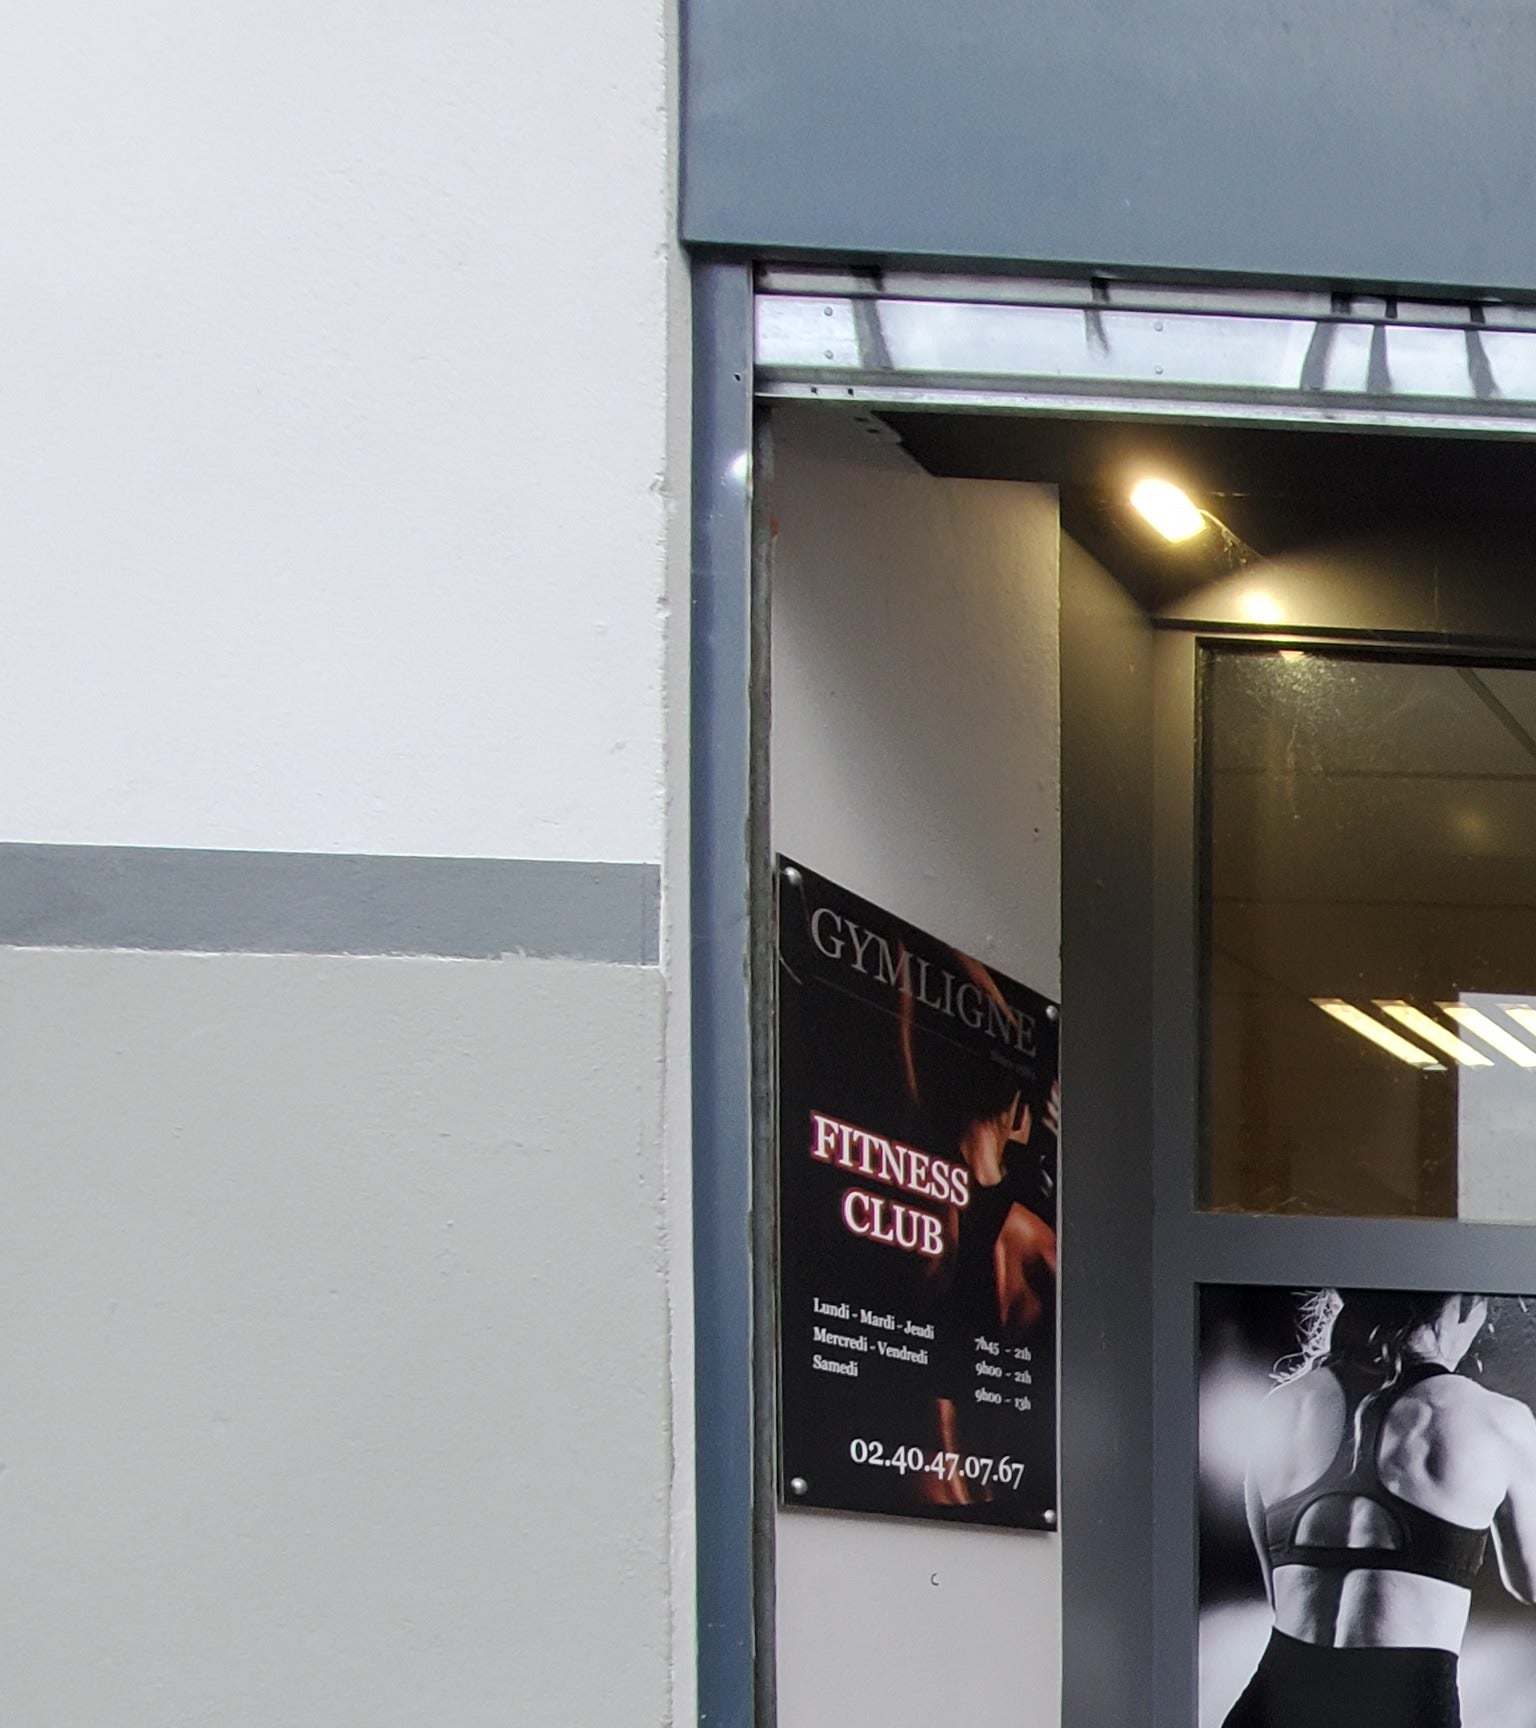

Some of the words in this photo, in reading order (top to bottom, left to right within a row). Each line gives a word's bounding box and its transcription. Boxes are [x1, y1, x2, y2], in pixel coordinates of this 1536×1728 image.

[812, 908, 1036, 1056] GYMLIGNE
[812, 1112, 970, 1207] FITNESS
[844, 1191, 943, 1254] CLUB
[813, 1298, 850, 1320] Lundi
[860, 1309, 895, 1330] Mardi
[904, 1320, 935, 1340] Jeudi
[812, 1354, 859, 1377] Samedi
[813, 1326, 868, 1352] Mercredi
[877, 1341, 929, 1365] Vendredi
[974, 1336, 1000, 1356] 7h45
[1015, 1346, 1032, 1361] 21h
[975, 1361, 1002, 1378] 9h00
[1015, 1370, 1032, 1384] 21h
[975, 1388, 1002, 1404] 9h00
[1014, 1396, 1032, 1411] 13h
[850, 1438, 1025, 1490] 02.40.47.07.67
